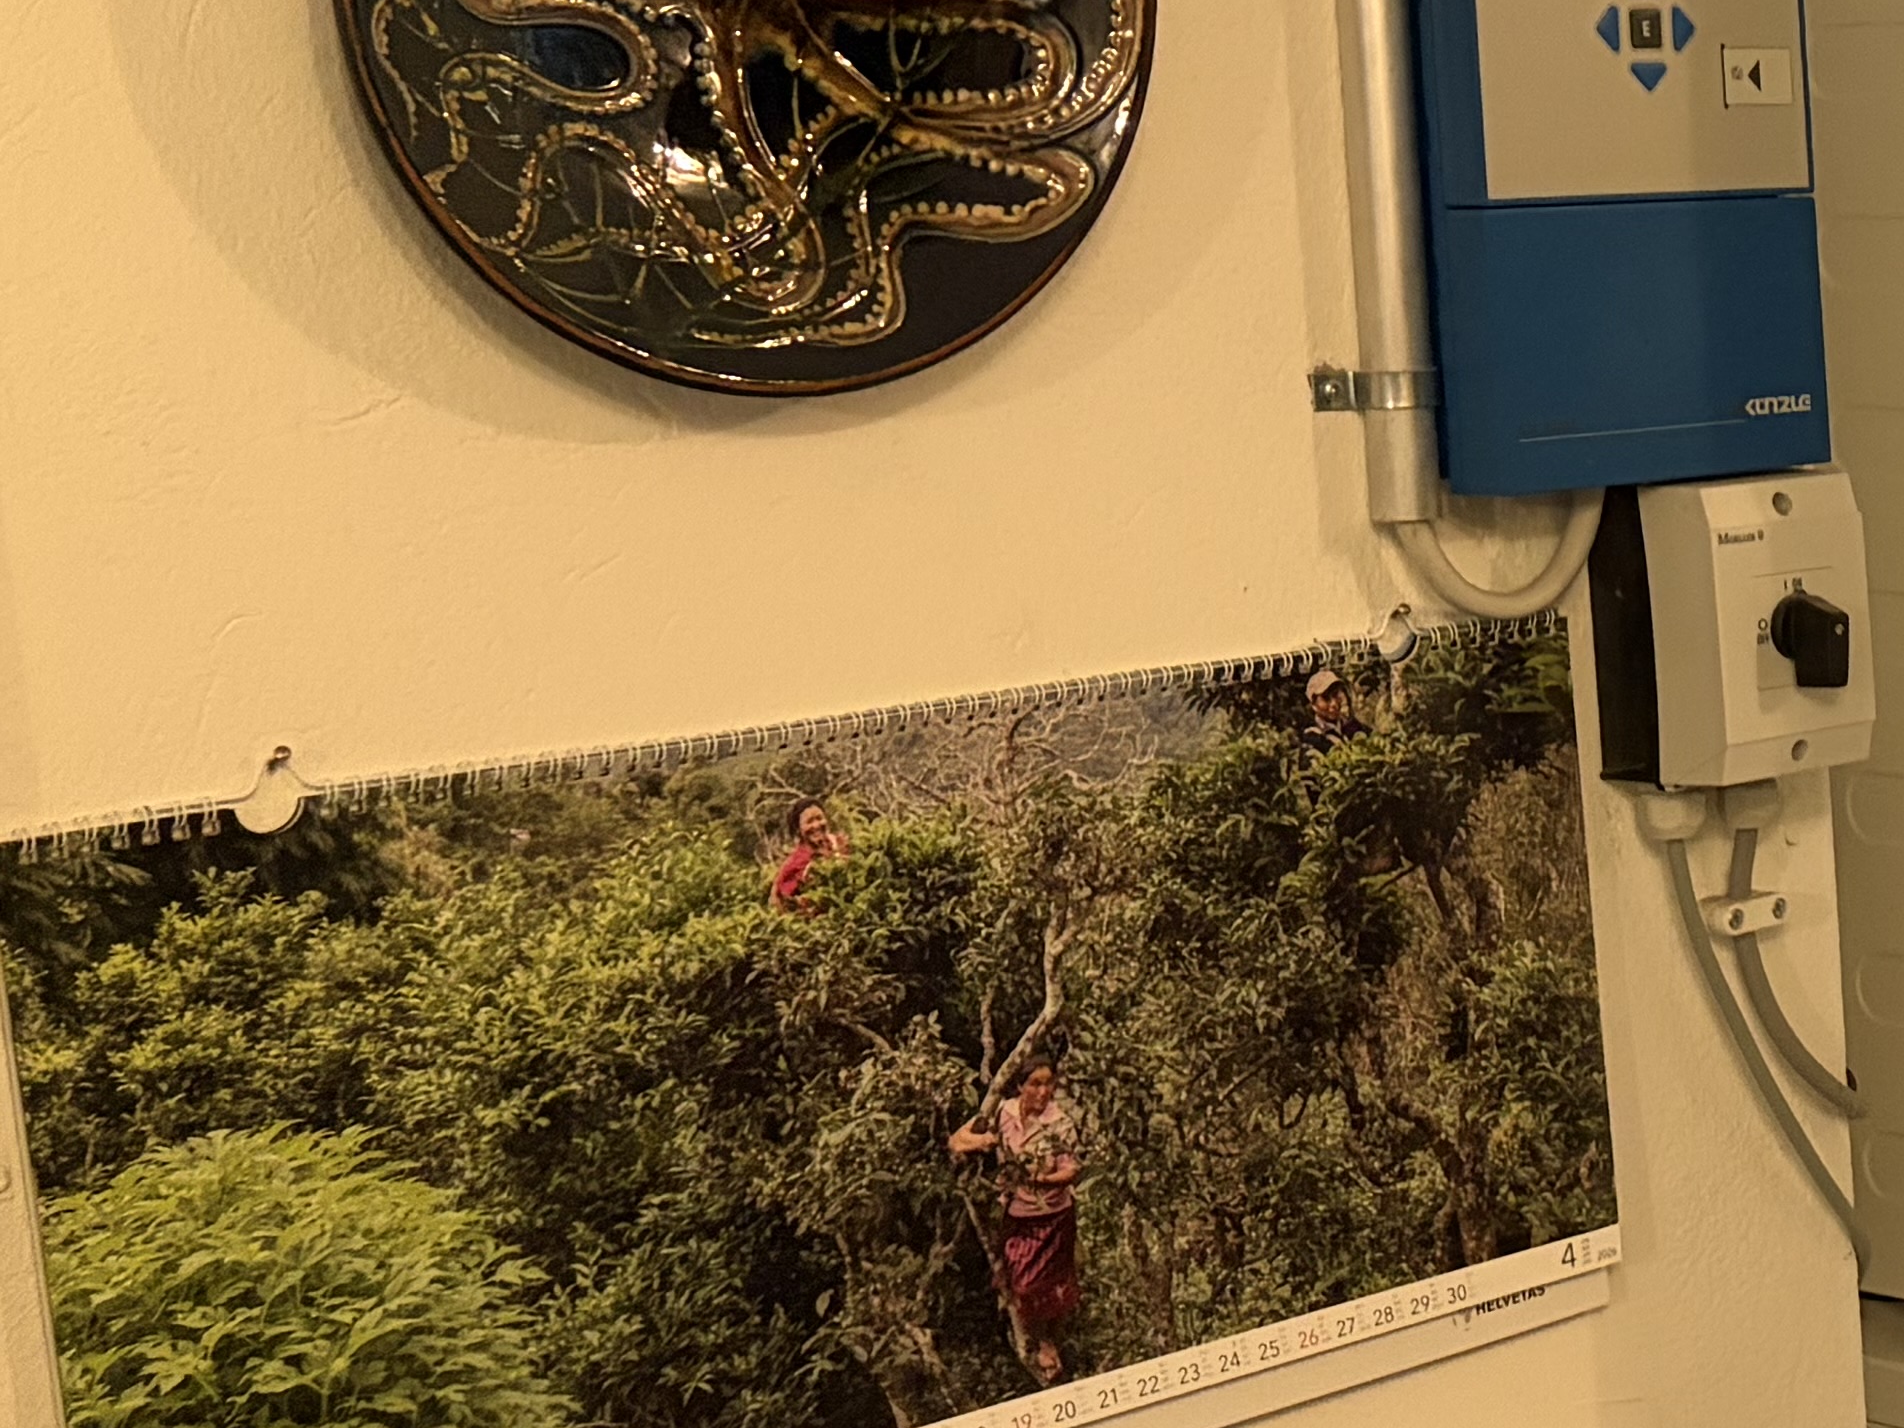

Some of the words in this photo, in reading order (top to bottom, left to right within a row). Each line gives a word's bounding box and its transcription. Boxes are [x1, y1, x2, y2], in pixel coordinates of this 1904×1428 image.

[1642, 20, 1650, 37] E
[1560, 1242, 1577, 1268] 4
[1476, 1285, 1546, 1316] HELVETAS
[1053, 1400, 1076, 1422] 20
[1098, 1388, 1118, 1409] 21
[1137, 1375, 1160, 1397] 22
[1178, 1363, 1201, 1385] 23
[1218, 1351, 1240, 1373] 24
[1258, 1339, 1280, 1361] 25
[1298, 1328, 1320, 1349] 26
[1336, 1317, 1355, 1339] 27
[1373, 1306, 1395, 1327] 28
[1410, 1295, 1430, 1316] 29
[1447, 1284, 1467, 1304] 30
